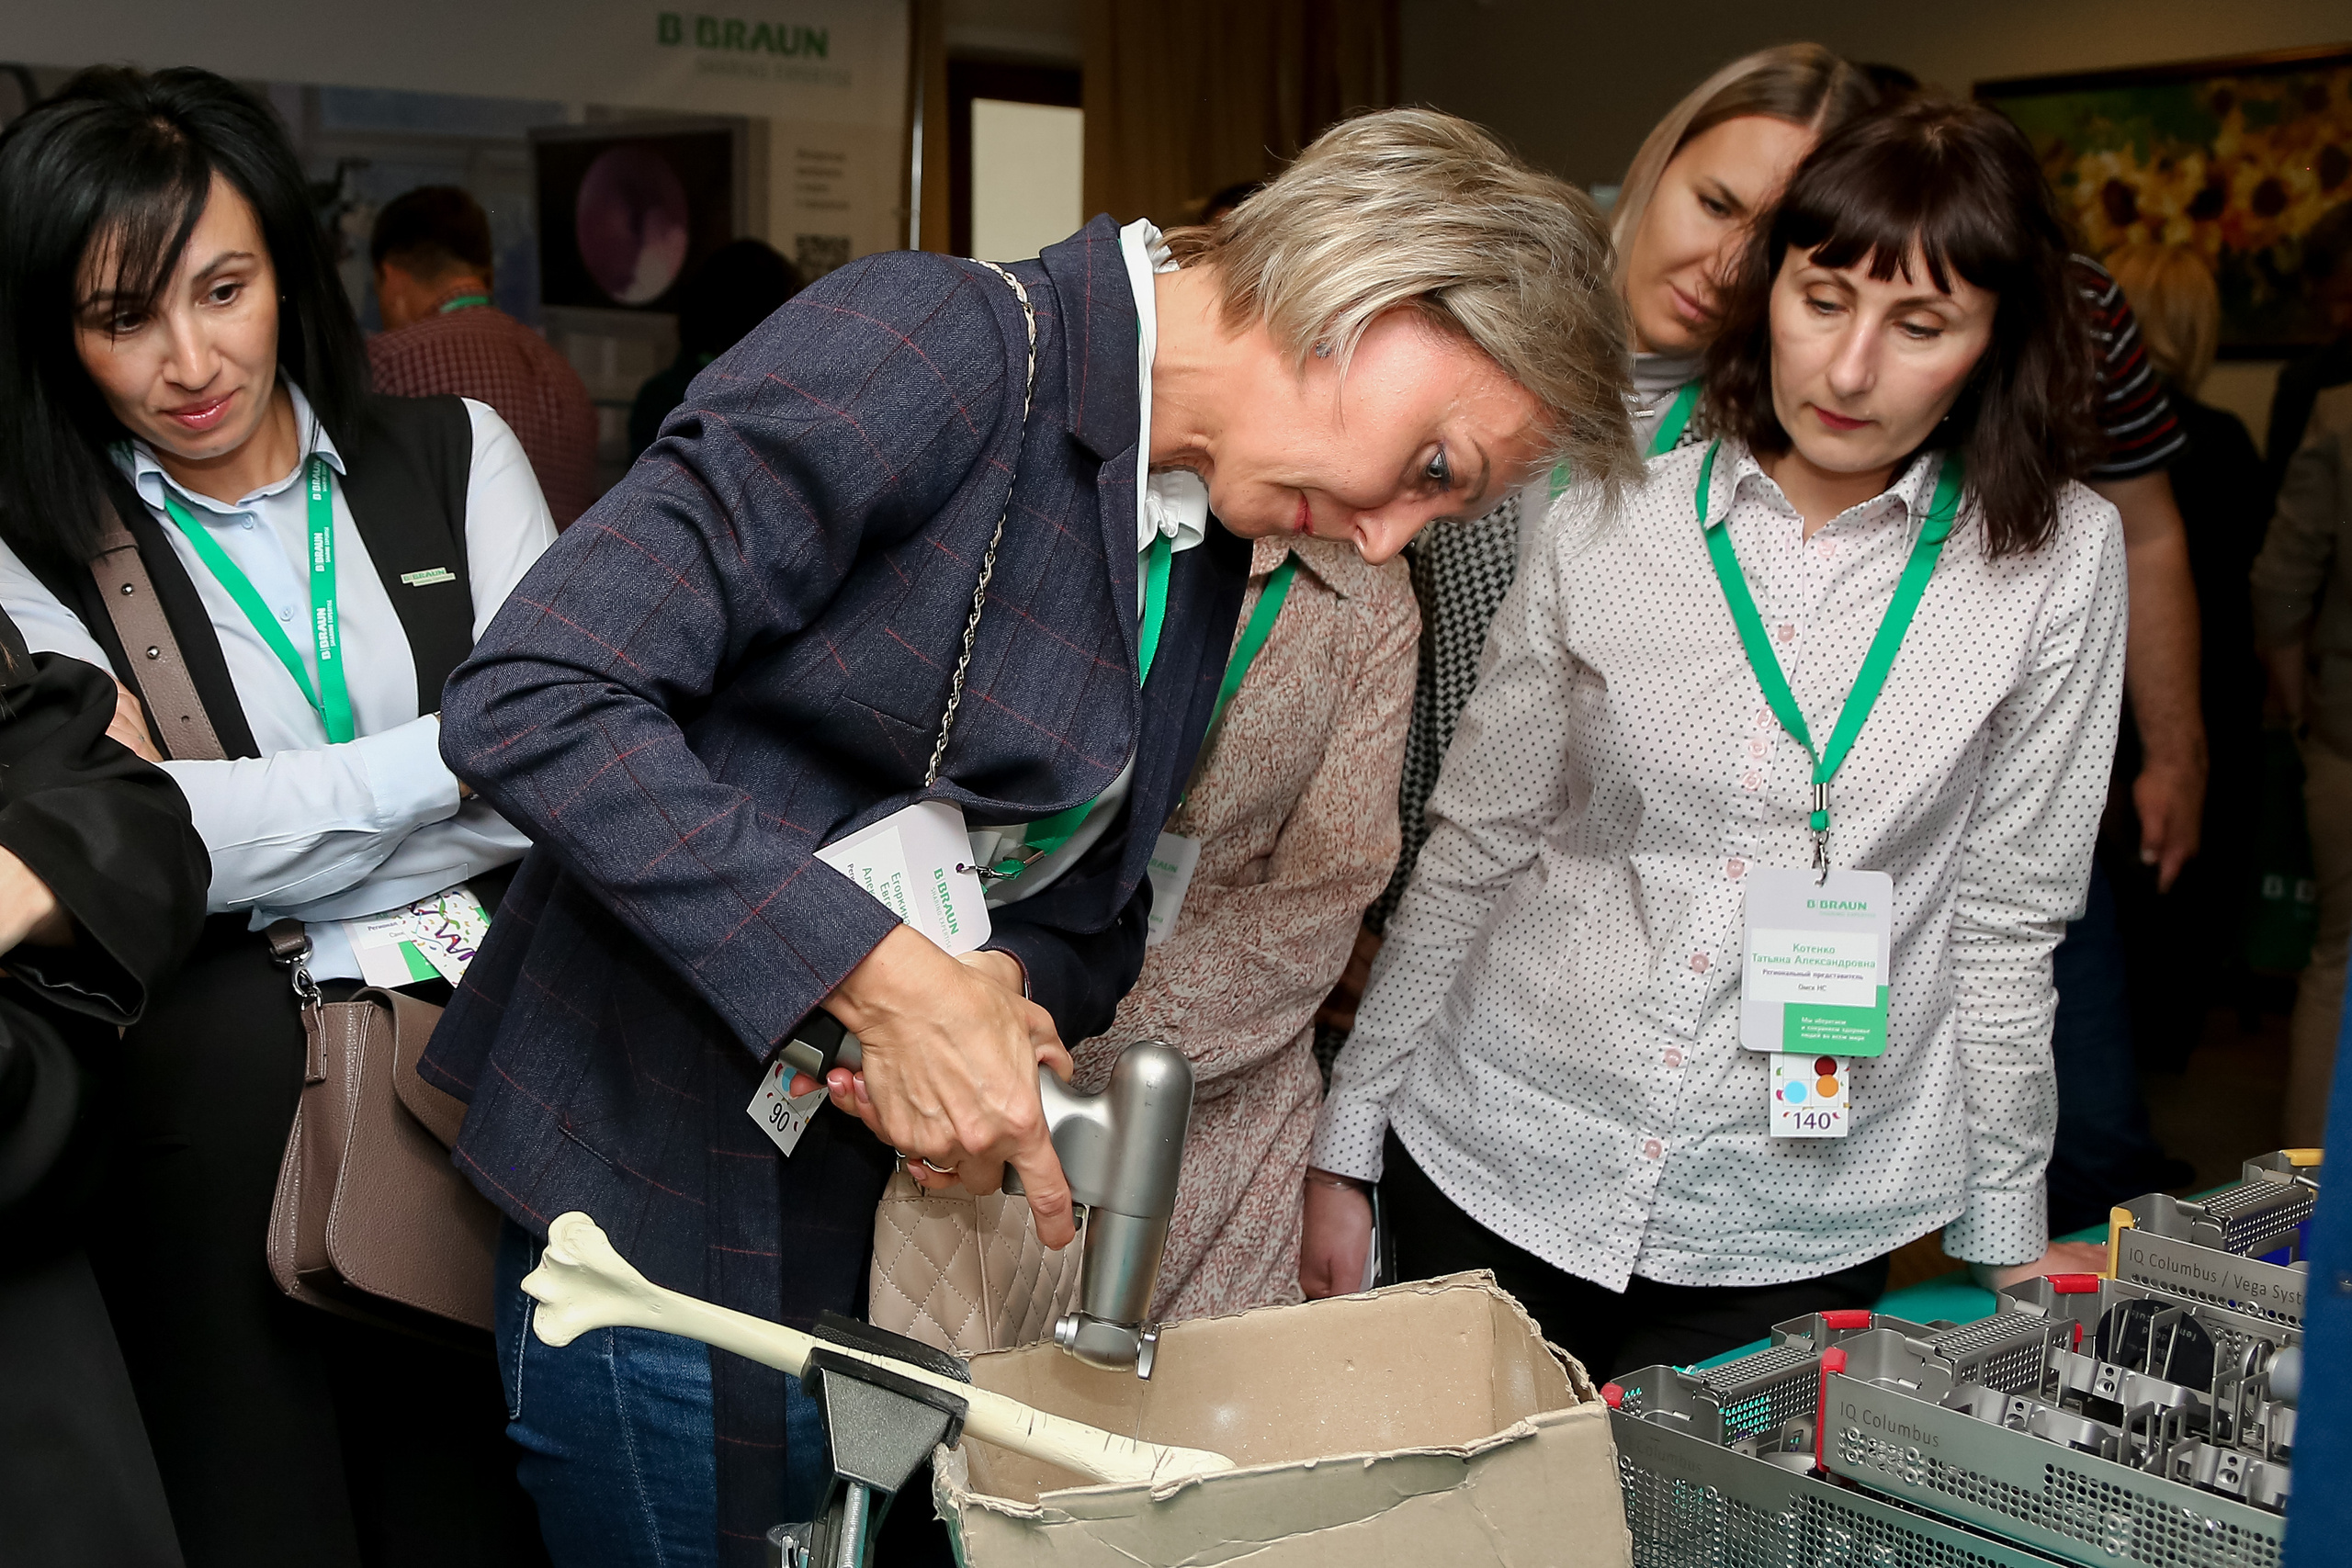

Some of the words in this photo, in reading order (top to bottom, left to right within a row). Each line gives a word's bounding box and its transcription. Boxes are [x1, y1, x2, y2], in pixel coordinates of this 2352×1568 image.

[695, 16, 829, 57] BRAUN
[313, 532, 324, 563] BRAUN
[316, 607, 330, 649] BRAUN
[879, 881, 894, 910] Евге
[937, 881, 959, 935] BRAUN
[1820, 900, 1868, 909] BRAUN
[1752, 953, 1791, 964] Татьяна
[1794, 955, 1876, 969] Александровна
[1792, 943, 1836, 954] Котенко
[769, 1102, 790, 1132] 90
[1792, 1111, 1831, 1130] 140
[2129, 1247, 2144, 1264] IQ
[2149, 1253, 2217, 1283] Columbus
[2233, 1273, 2267, 1298] Vega
[1840, 1402, 1857, 1422] IQ
[1862, 1409, 1939, 1448] Columbus
